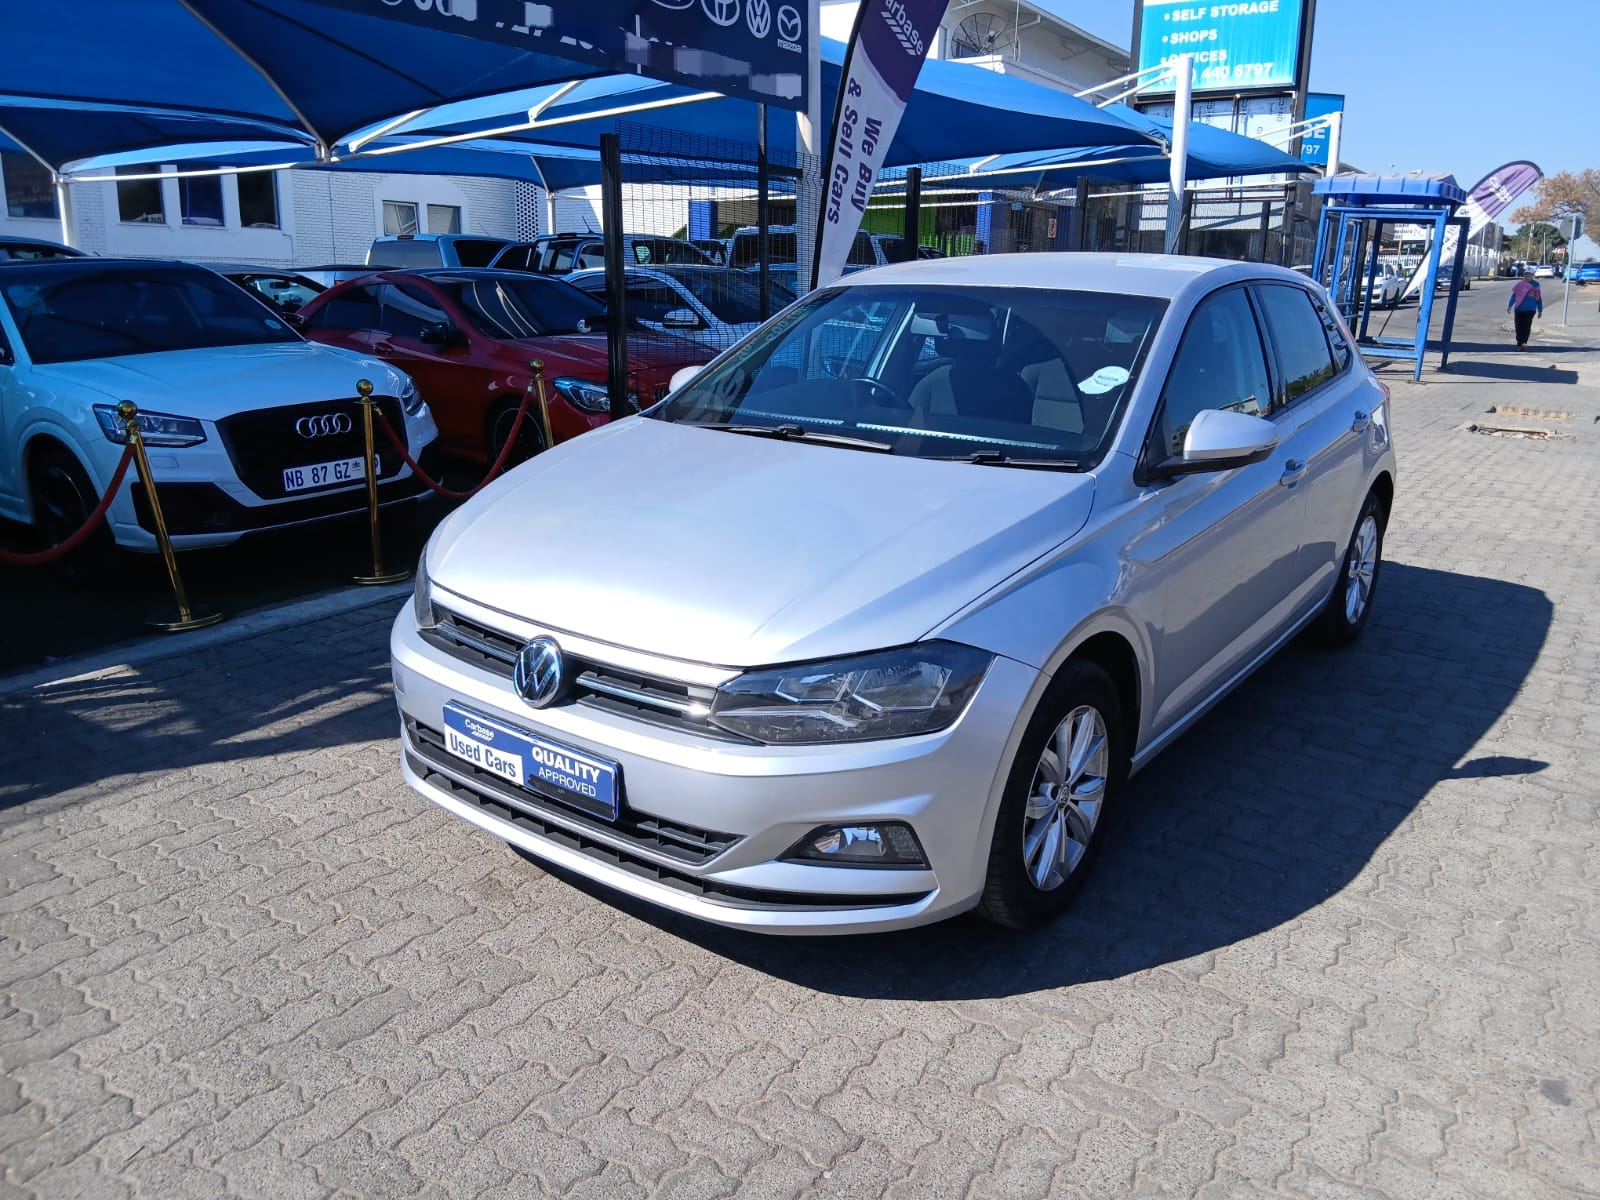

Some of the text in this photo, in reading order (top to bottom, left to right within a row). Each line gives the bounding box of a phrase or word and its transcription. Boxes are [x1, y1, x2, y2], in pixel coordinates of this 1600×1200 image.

[1172, 0, 1279, 22] SELF STORAGE
[885, 0, 924, 56] arbase
[1170, 29, 1218, 45] SHOPS
[777, 39, 802, 53] mazda
[1201, 65, 1230, 81] 440
[827, 77, 862, 225] & Sell Cars
[851, 116, 882, 214] We Buy
[285, 470, 304, 489] NB
[311, 465, 328, 484] 87
[334, 462, 352, 480] GZ
[464, 718, 495, 738] Carbase
[450, 732, 516, 778] Used Cars
[532, 746, 600, 784] QUALITY
[538, 766, 597, 798] APPROVED
